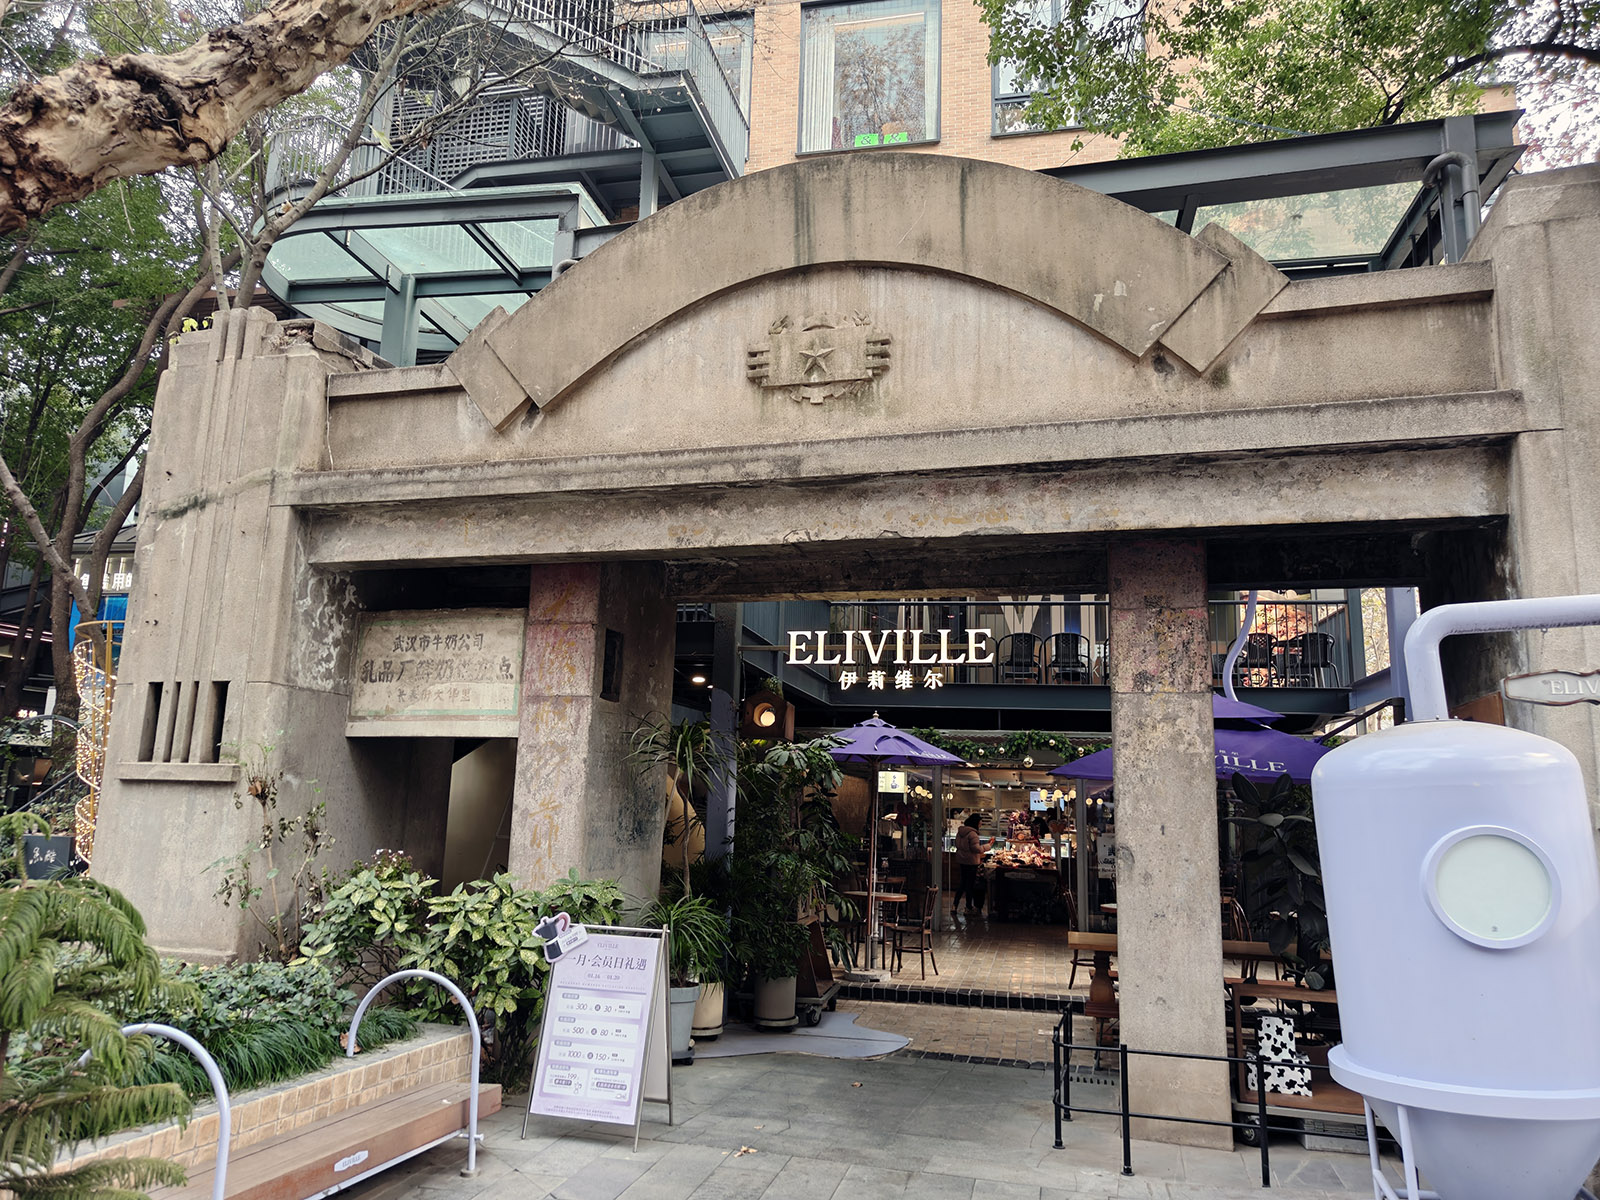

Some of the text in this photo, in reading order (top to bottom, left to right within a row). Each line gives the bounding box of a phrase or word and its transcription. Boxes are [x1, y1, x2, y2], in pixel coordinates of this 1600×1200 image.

[392, 633, 485, 653] 武汉市牛奶公司
[785, 628, 995, 666] ELIVILLE
[838, 669, 944, 691] 伊莉维尔
